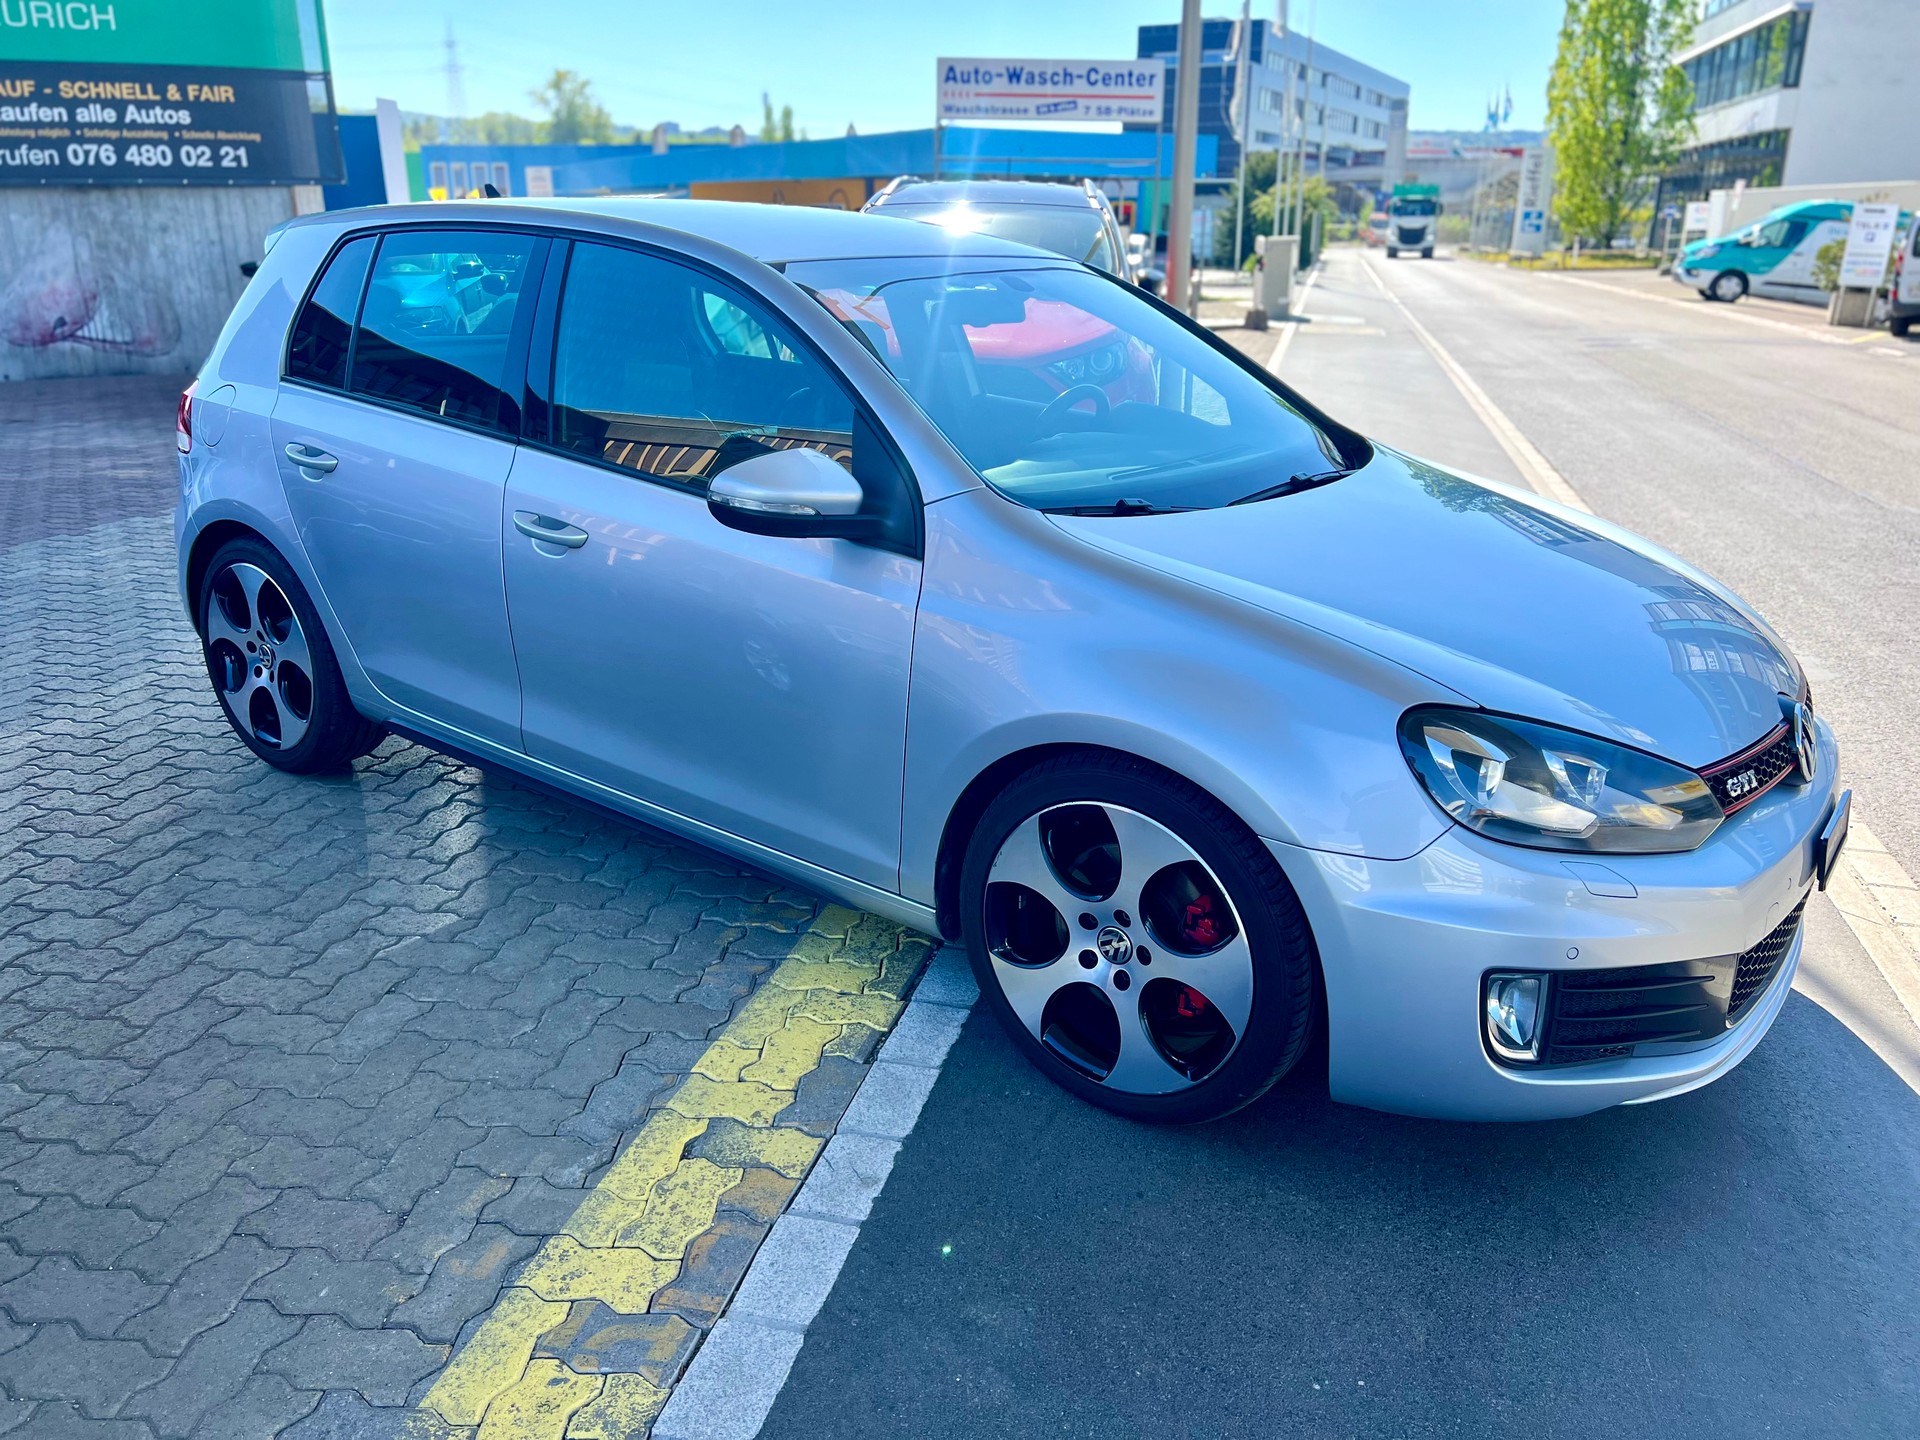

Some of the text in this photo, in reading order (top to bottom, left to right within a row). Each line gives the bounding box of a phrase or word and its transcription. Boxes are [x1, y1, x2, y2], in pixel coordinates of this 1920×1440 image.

[0, 0, 117, 31] URICH
[944, 65, 1157, 87] Auto-Wasch-Center
[58, 80, 161, 101] SCHNELL
[166, 83, 182, 100] &
[187, 84, 235, 103] FAIR
[0, 102, 192, 125] aufen alle Autos
[66, 144, 117, 167] 076
[124, 144, 172, 167] 480
[180, 145, 214, 168] 02
[219, 146, 249, 168] 21
[1726, 769, 1758, 798] GTI
